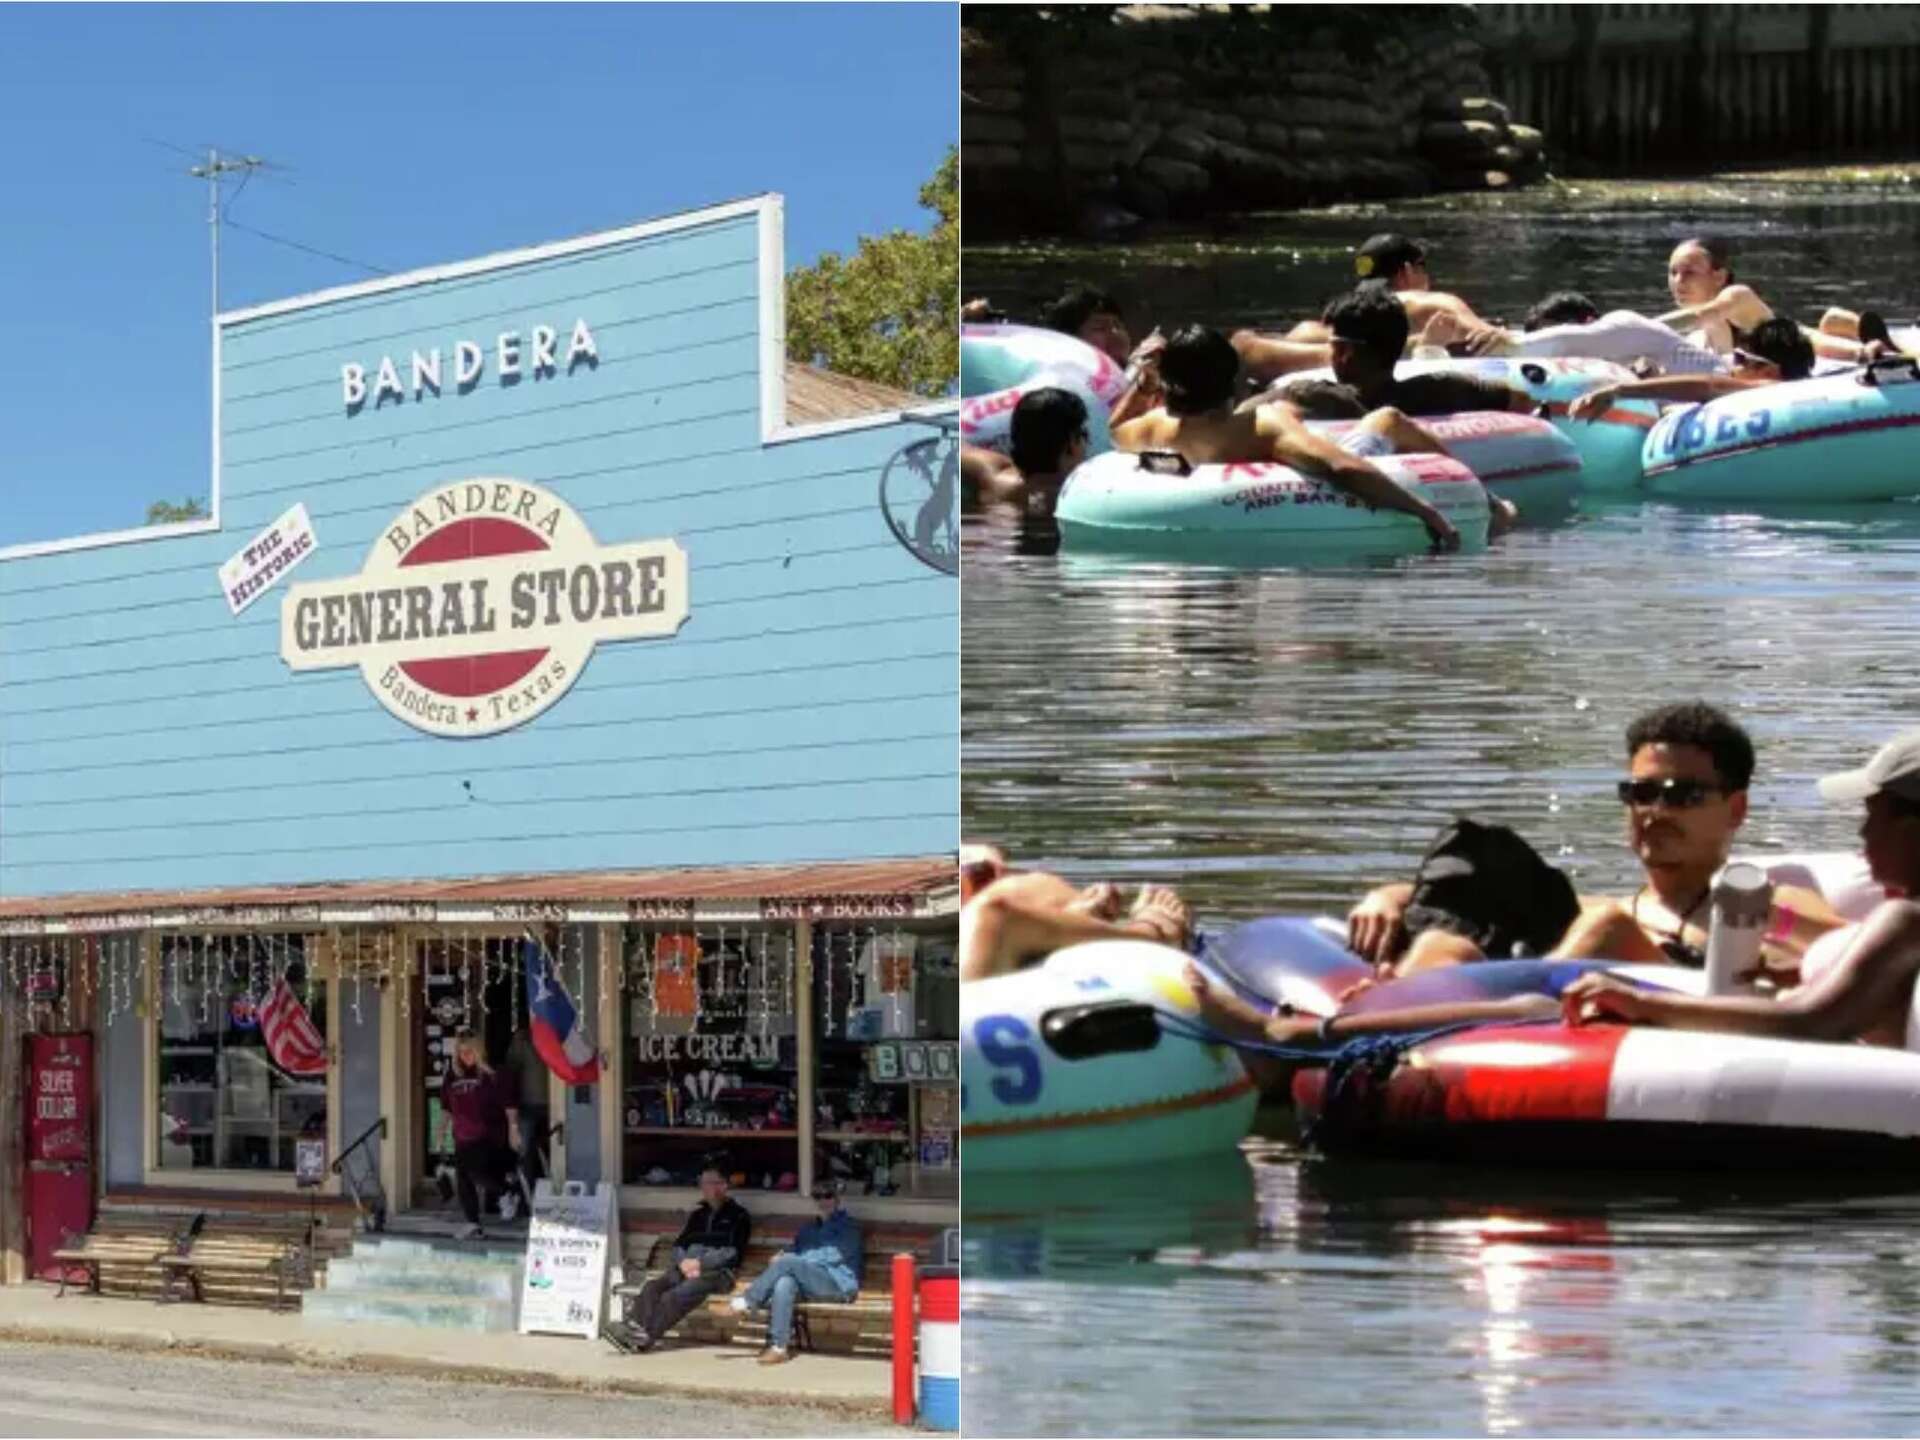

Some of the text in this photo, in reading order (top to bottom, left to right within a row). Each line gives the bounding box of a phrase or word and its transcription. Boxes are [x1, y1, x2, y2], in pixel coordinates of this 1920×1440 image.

[341, 317, 599, 412] BANDERA
[385, 484, 561, 553] BANDERA
[1244, 493, 1286, 513] AND
[231, 531, 312, 606] HISTORIC
[243, 528, 283, 567] THE
[294, 555, 666, 650] GENERAL STORE
[379, 660, 567, 725] Bandera Texas
[765, 896, 907, 919] ART BOOKS
[638, 1033, 779, 1062] ICE CREAM
[37, 1096, 76, 1119] DOLLAR
